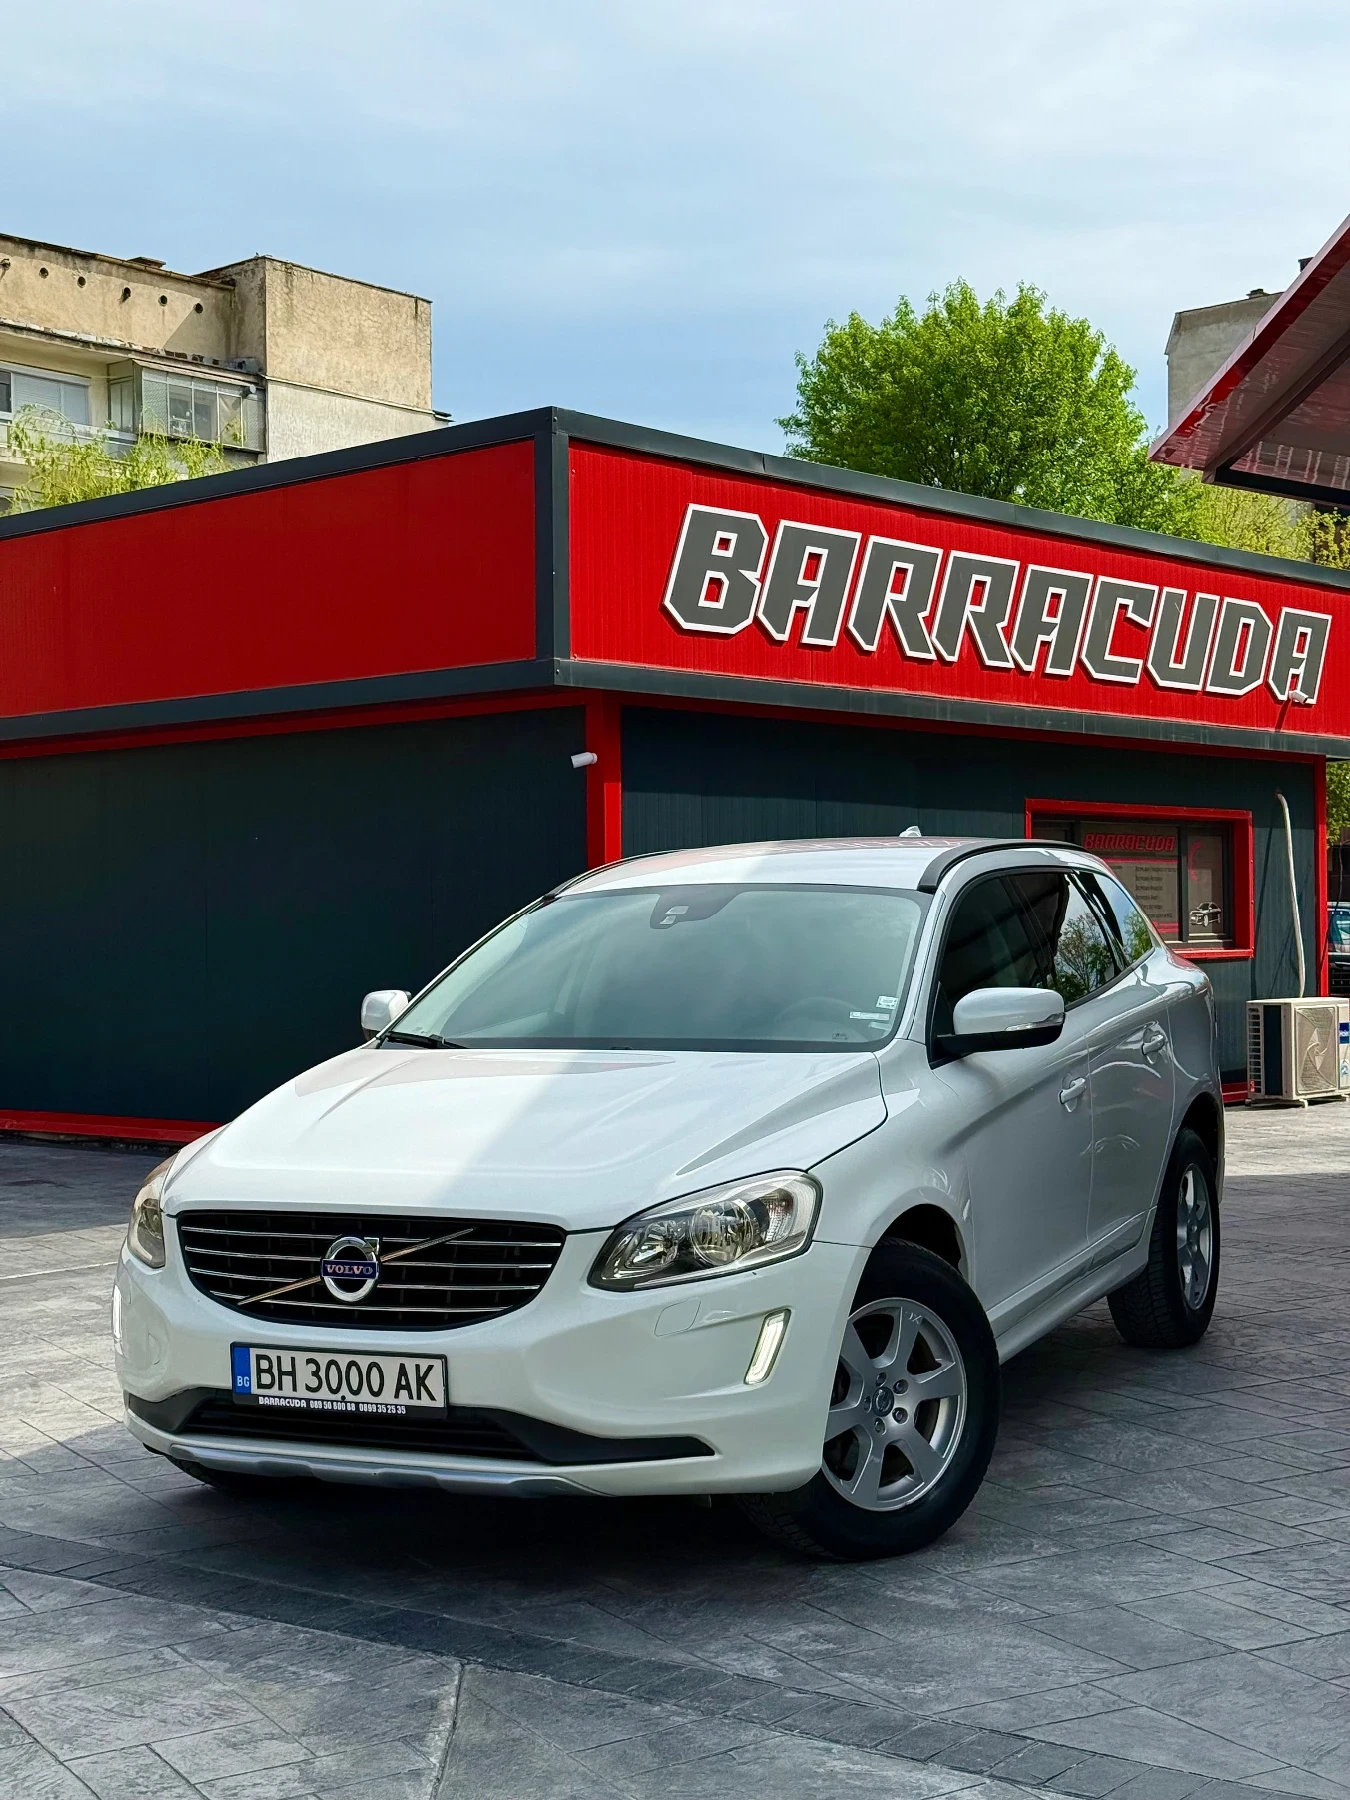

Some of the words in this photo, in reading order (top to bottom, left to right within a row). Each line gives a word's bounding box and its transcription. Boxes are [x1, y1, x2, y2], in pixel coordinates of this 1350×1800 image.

[663, 502, 1333, 706] BARRACUDA
[1084, 833, 1175, 851] BARRACUDA
[325, 1263, 374, 1275] VOLVO
[236, 1375, 250, 1388] BG
[254, 1353, 298, 1393] BH
[304, 1357, 385, 1398] 3000
[393, 1362, 437, 1402] AK
[258, 1396, 307, 1408] BARRACUDA
